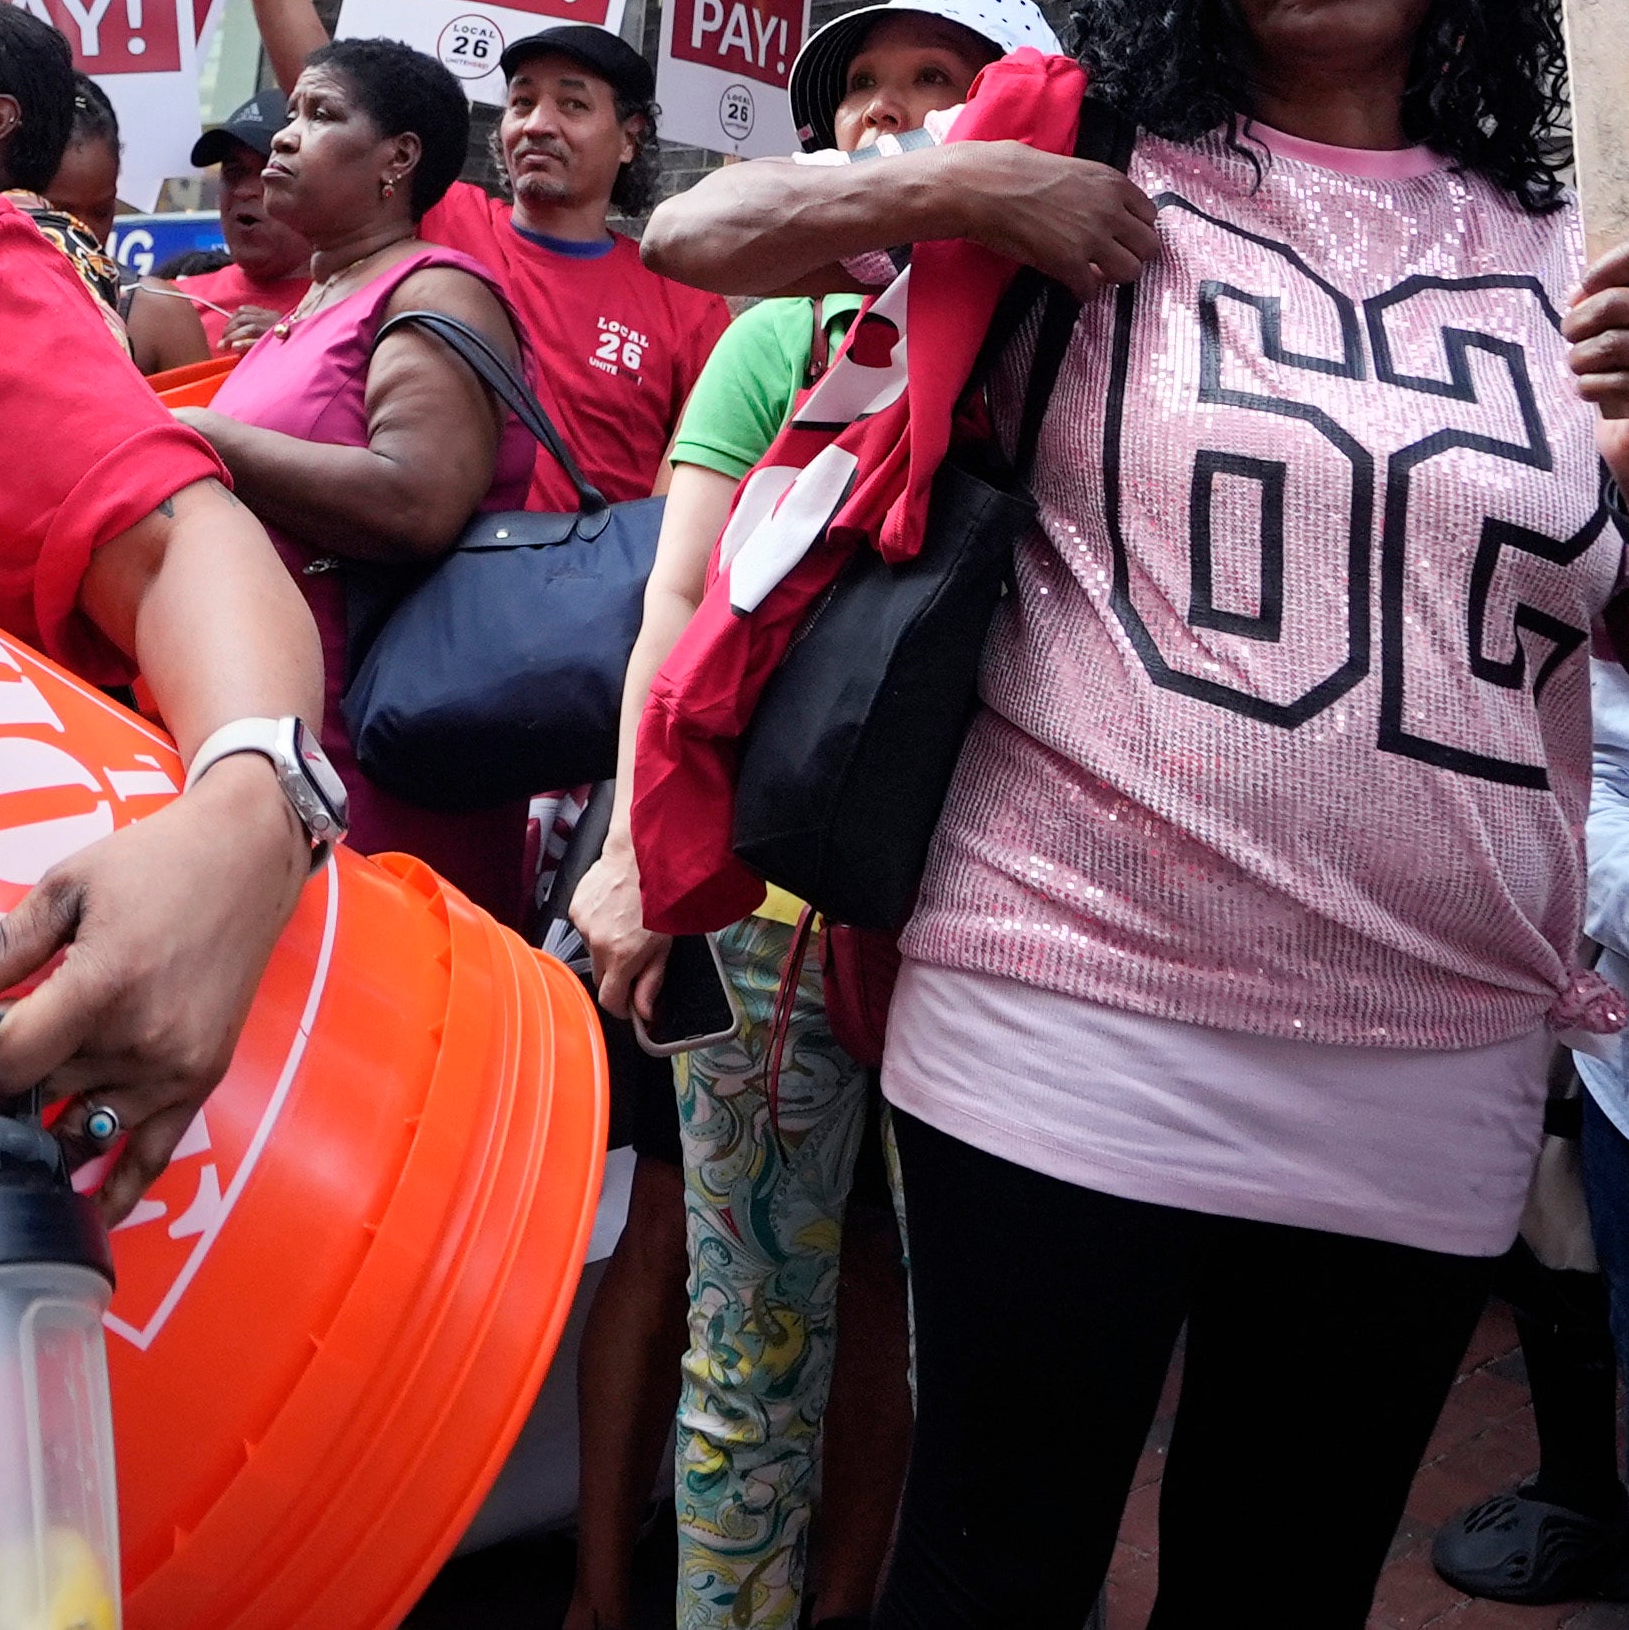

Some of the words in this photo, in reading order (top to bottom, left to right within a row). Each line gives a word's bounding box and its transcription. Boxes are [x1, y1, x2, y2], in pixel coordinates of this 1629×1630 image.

[453, 24, 497, 39] LOCAL
[452, 36, 490, 58] 26
[728, 103, 749, 123] 26
[596, 316, 650, 348] LOCAL
[595, 332, 643, 371] 26
